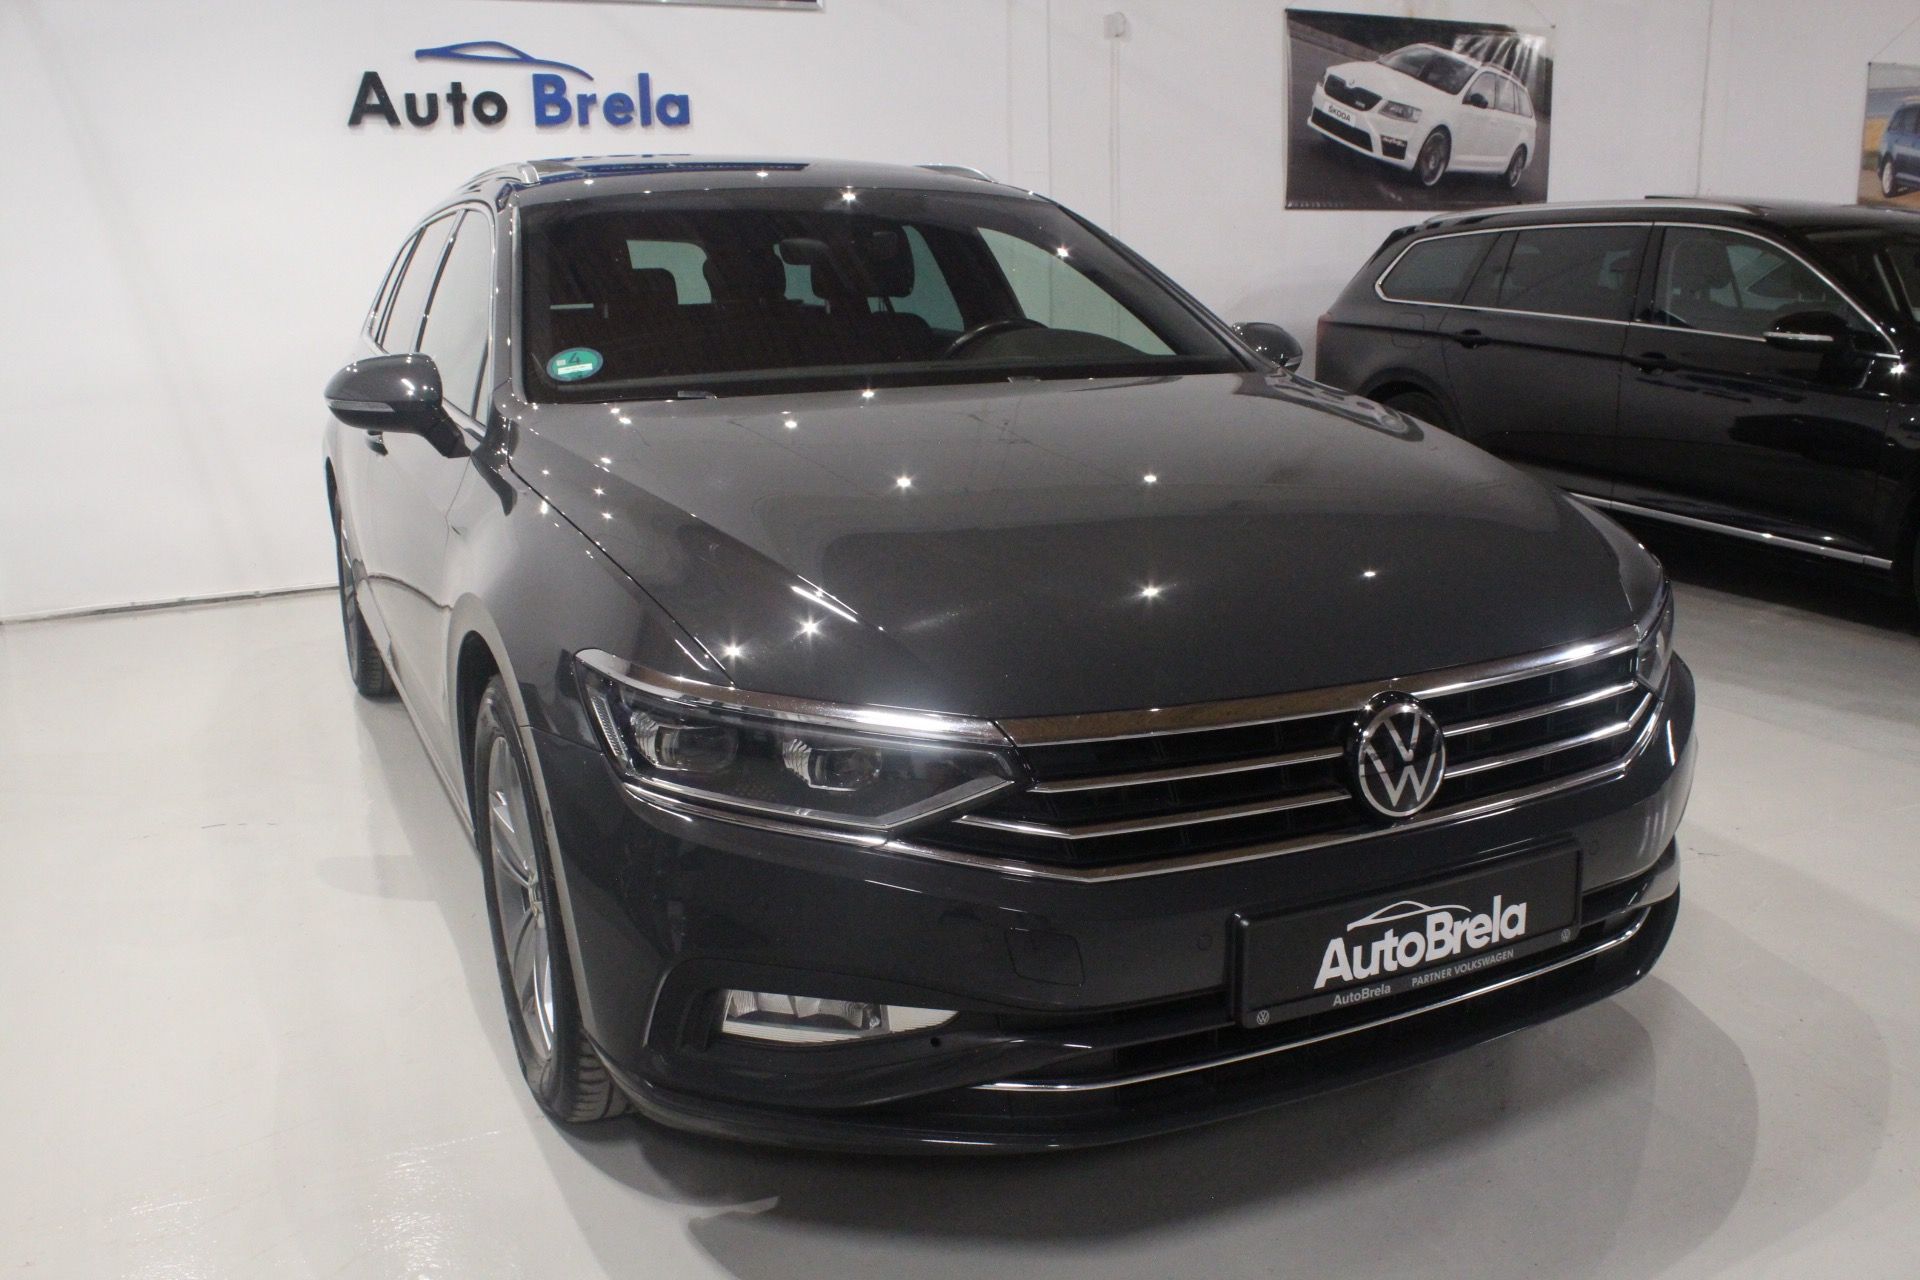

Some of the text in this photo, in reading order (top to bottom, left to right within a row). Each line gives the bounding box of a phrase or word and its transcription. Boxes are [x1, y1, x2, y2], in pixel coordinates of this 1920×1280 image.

[348, 71, 691, 127] Auto Brela
[568, 352, 581, 365] 4
[1333, 949, 1514, 1006] AutoBrela PARTNER VOLKSWAGEN
